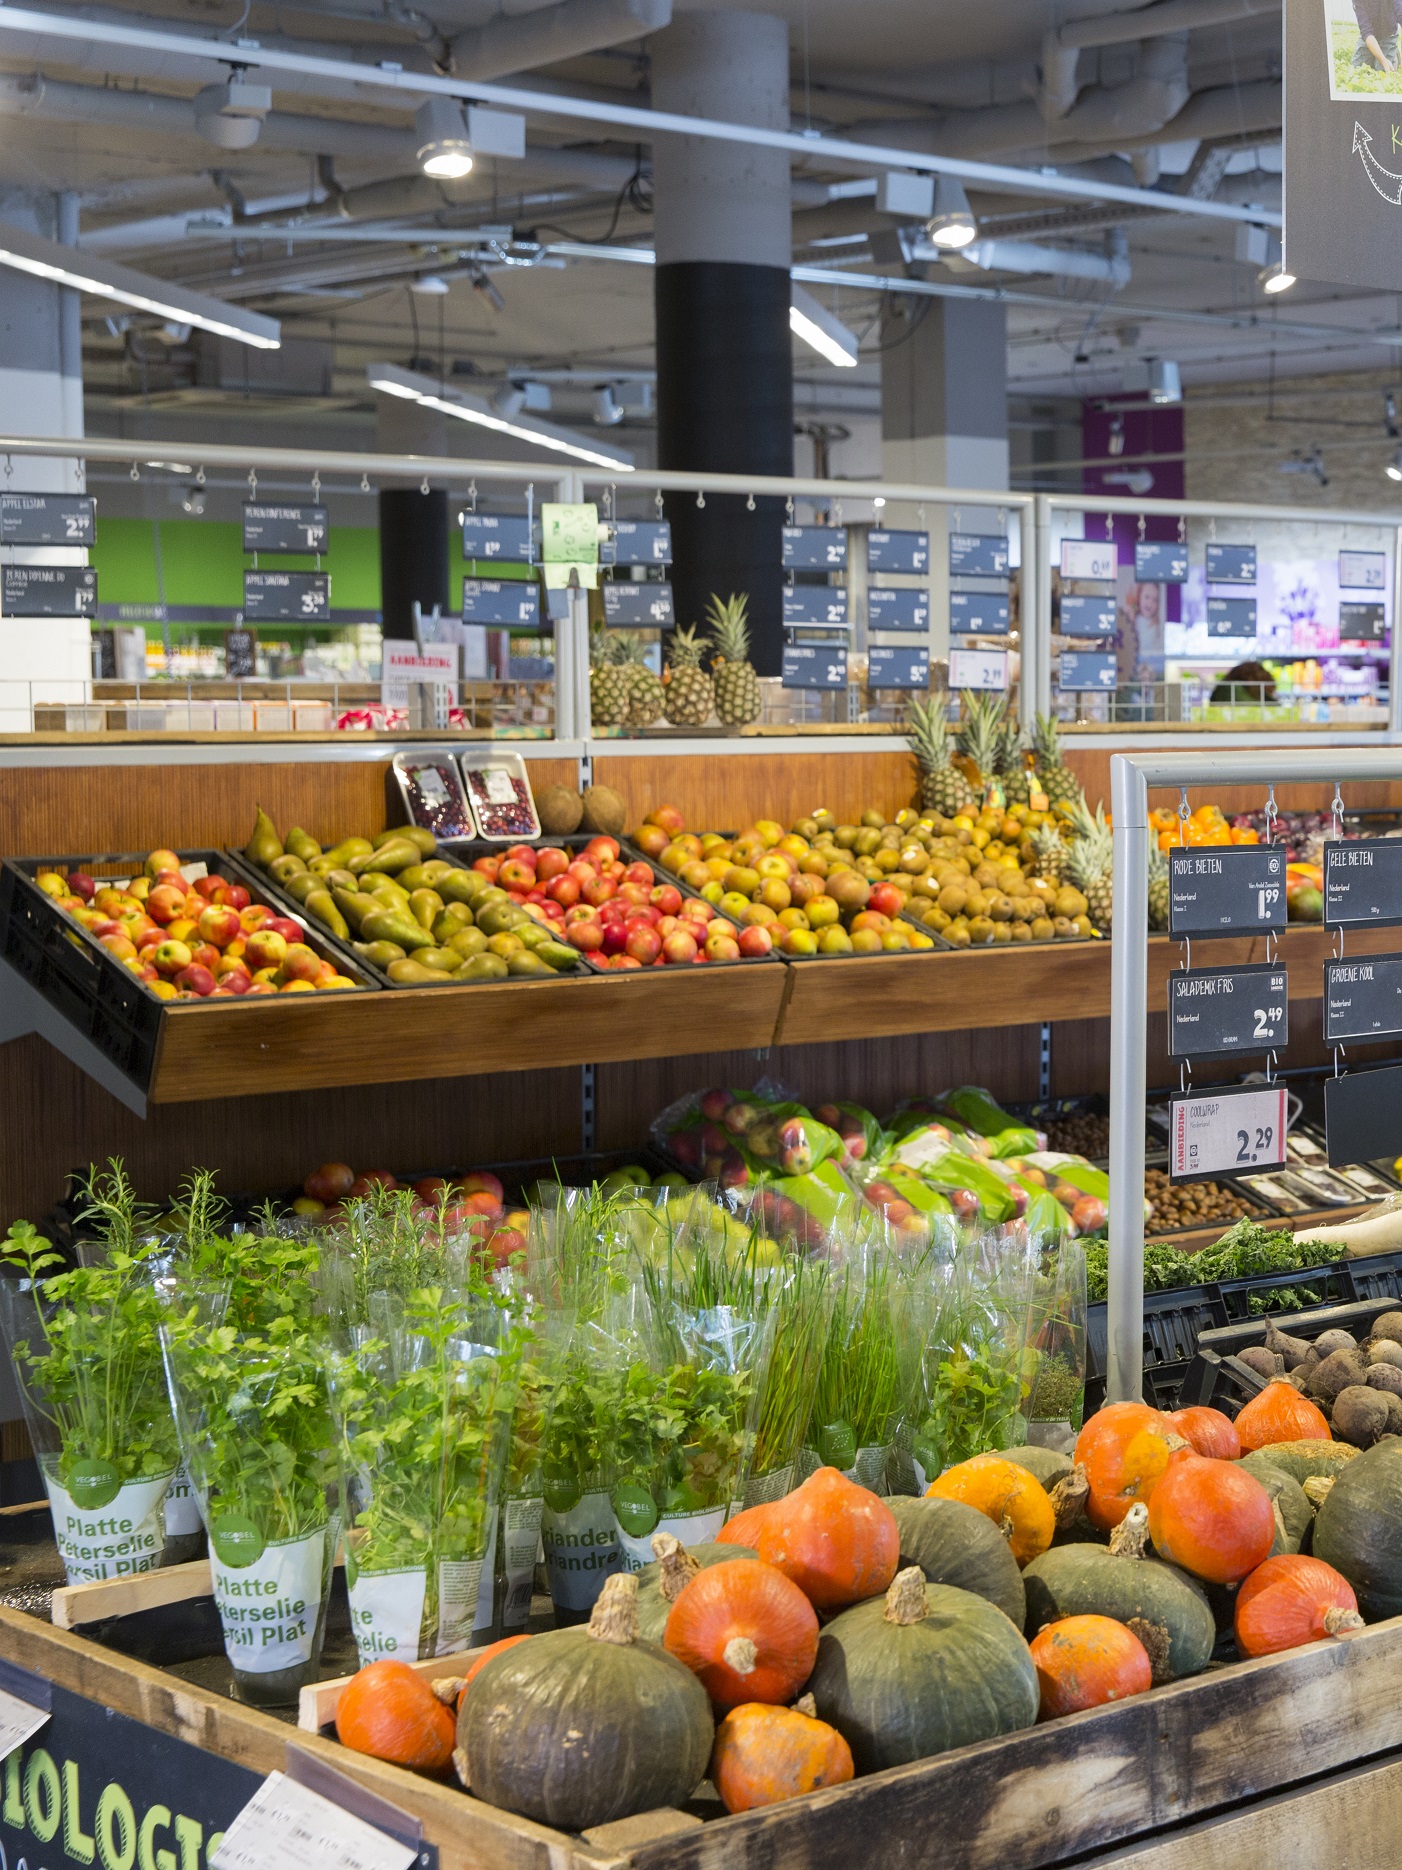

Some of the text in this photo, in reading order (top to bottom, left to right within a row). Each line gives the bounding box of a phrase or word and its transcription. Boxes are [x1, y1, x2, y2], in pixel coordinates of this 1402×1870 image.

[1330, 851, 1373, 866] GELE BIETEN
[1174, 859, 1222, 874] RODE BIETEN
[1329, 883, 1350, 891] Nederland
[1174, 892, 1196, 901] Nederland
[1258, 889, 1279, 919] 1.99
[1331, 966, 1374, 983] GROENE KOOL
[1177, 979, 1233, 997] SALADEMIX FRIS
[1331, 999, 1351, 1007] Nederland
[1177, 1013, 1199, 1023] Nederland
[1253, 1007, 1283, 1038] 2.49
[1190, 1121, 1210, 1129] Nederland
[1237, 1127, 1273, 1164] 2.29
[124, 1475, 152, 1485] CULTURE
[662, 1504, 726, 1519] CULTURE BIOLOGIQUE
[66, 1516, 133, 1537] Platte
[57, 1533, 155, 1560] Peterselie
[268, 1536, 297, 1546] CULTURE
[358, 1565, 426, 1577] CULTURE BIOLOGIQUE
[262, 1620, 307, 1646] Plat
